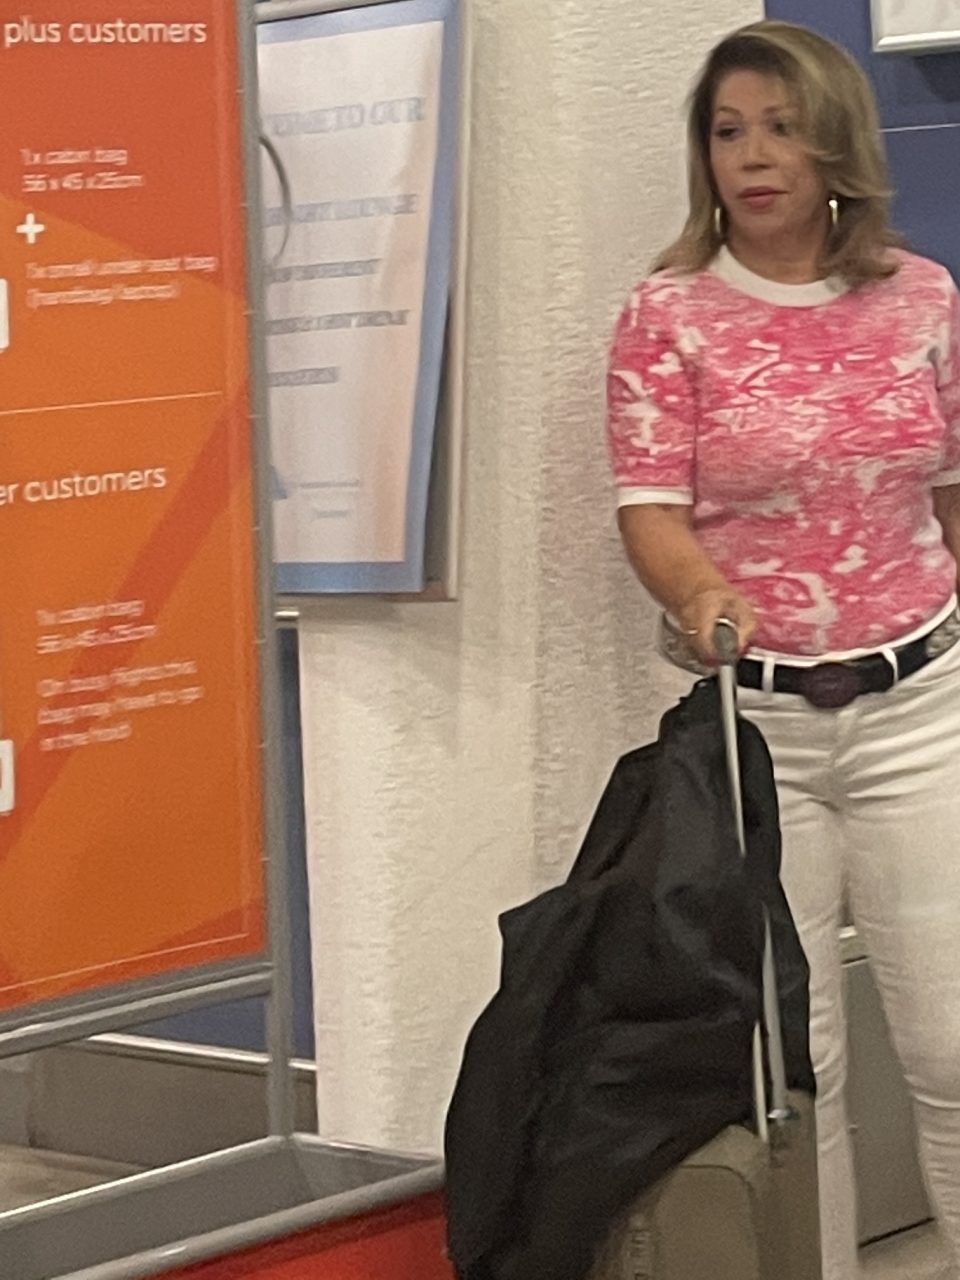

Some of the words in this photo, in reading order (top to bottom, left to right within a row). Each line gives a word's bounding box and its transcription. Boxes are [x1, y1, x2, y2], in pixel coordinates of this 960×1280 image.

[4, 15, 62, 48] plus
[68, 18, 208, 43] customers
[24, 467, 167, 502] customers
